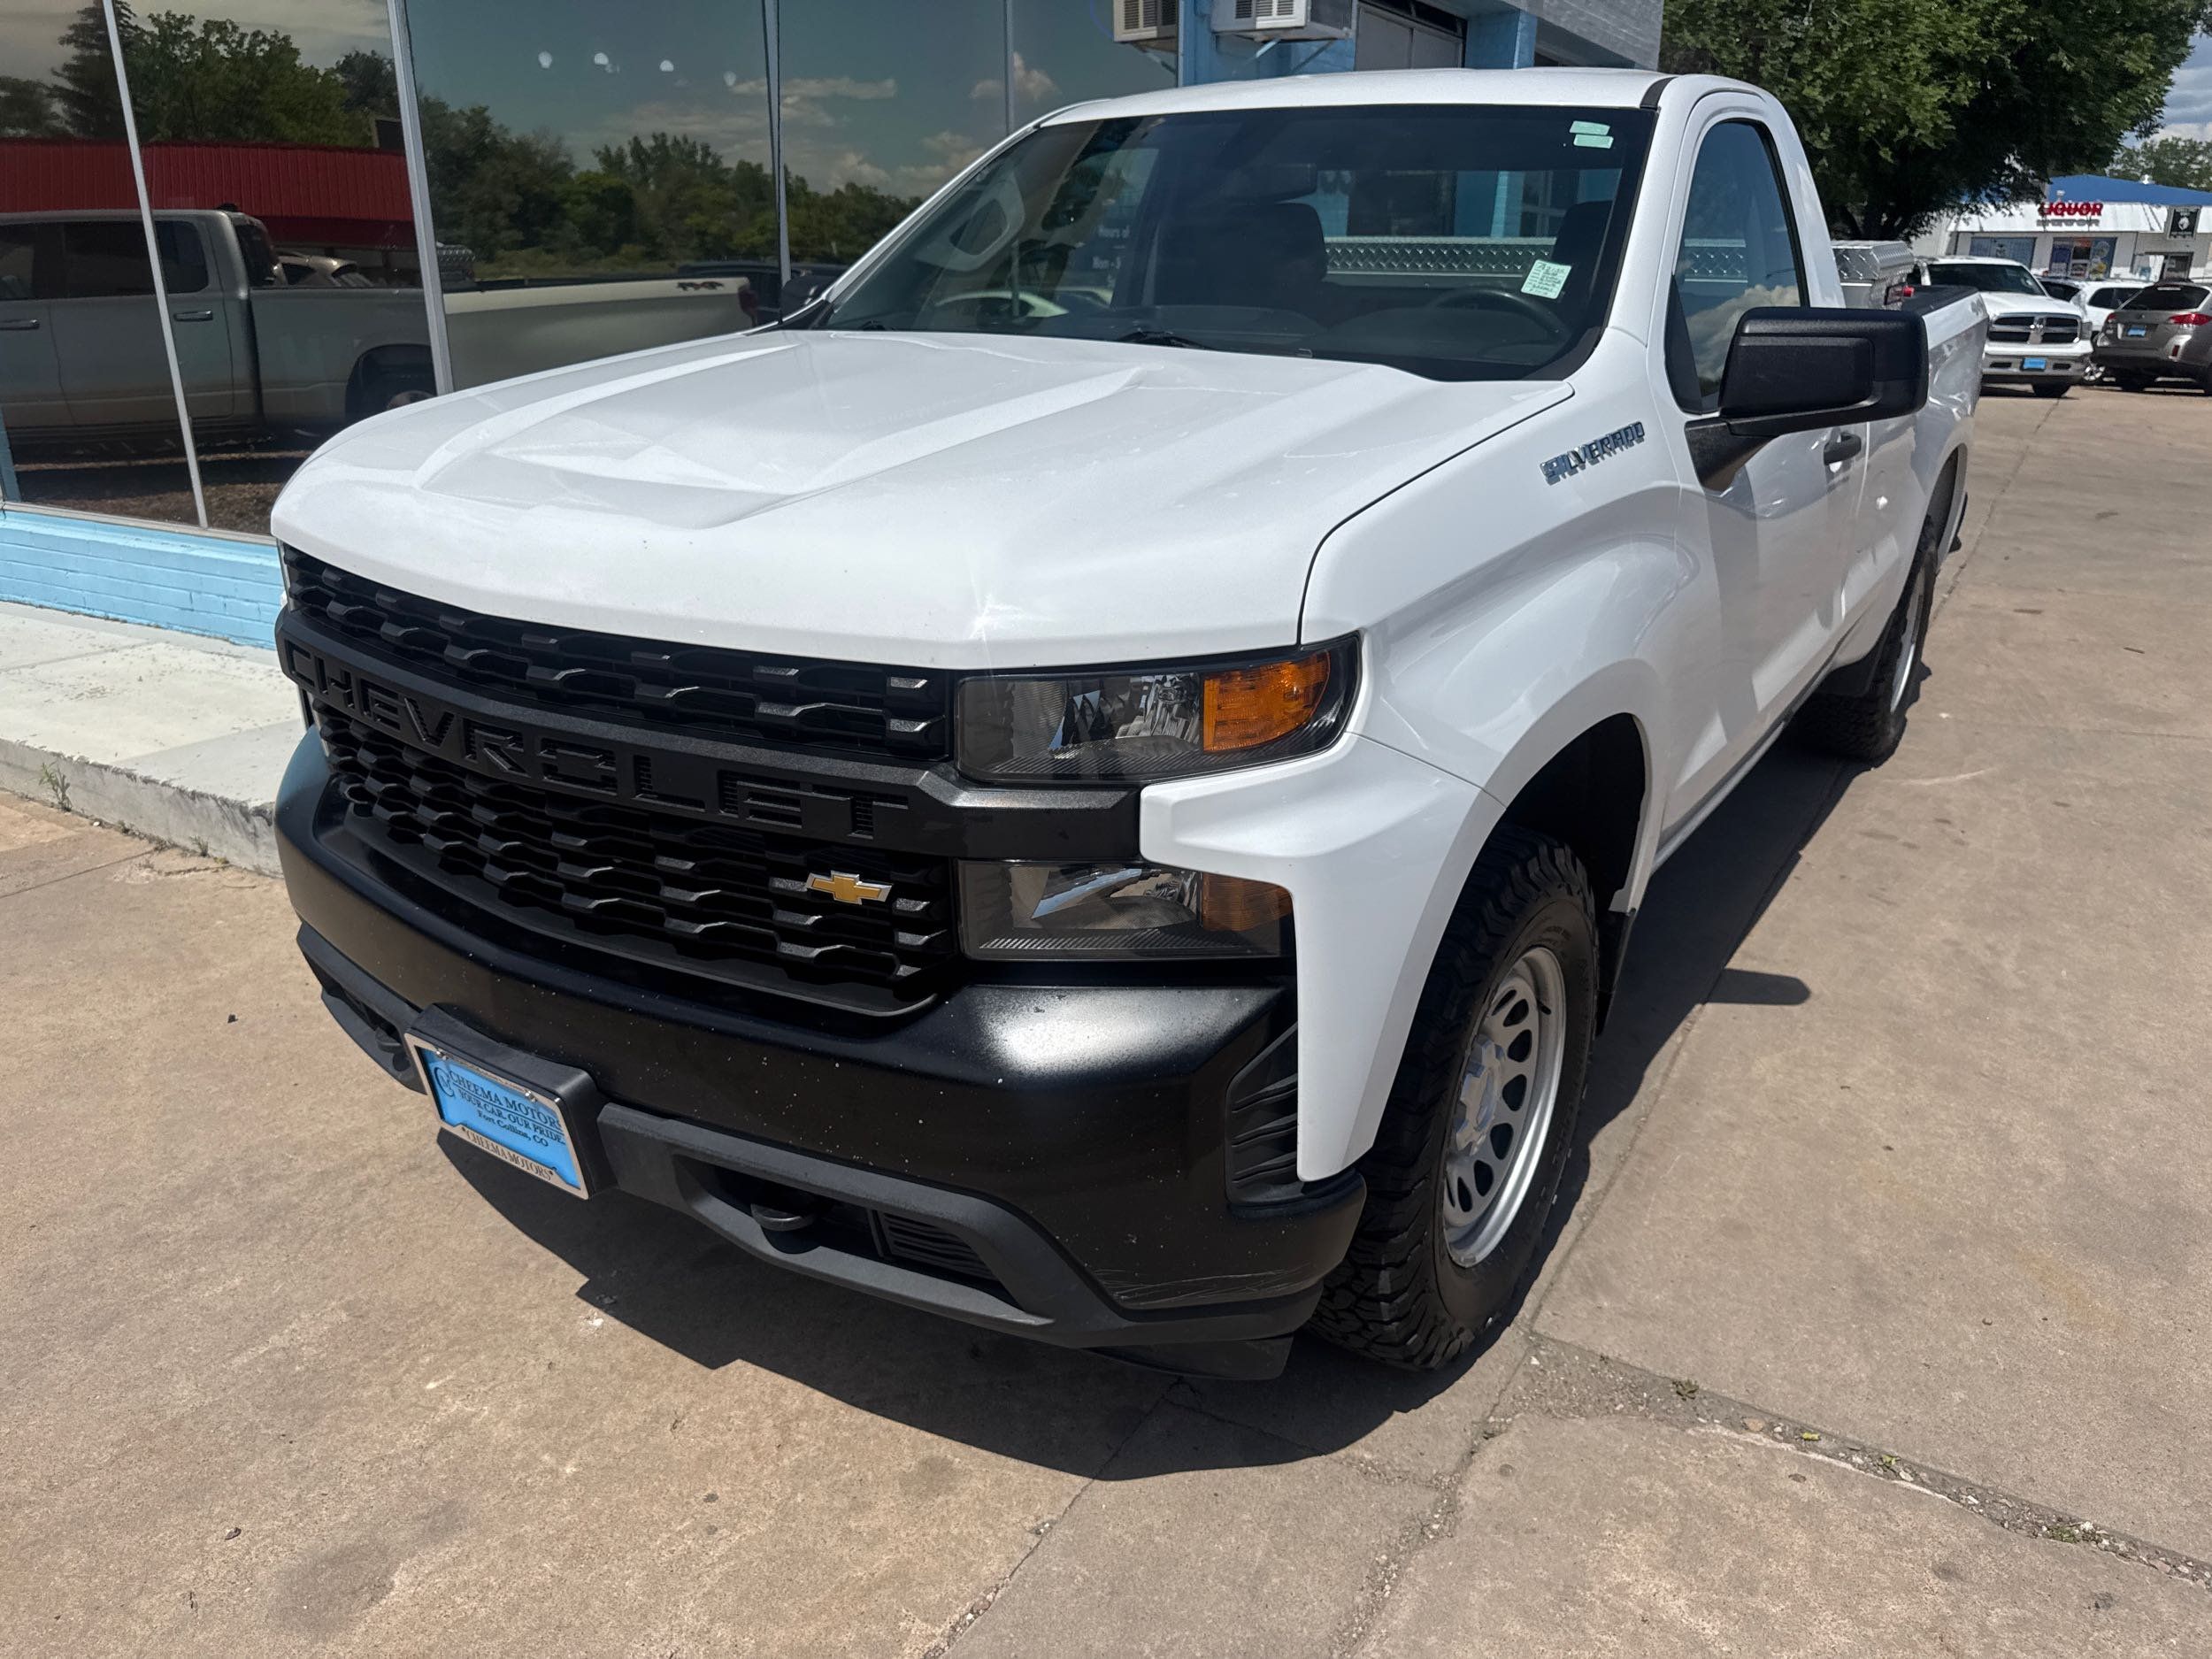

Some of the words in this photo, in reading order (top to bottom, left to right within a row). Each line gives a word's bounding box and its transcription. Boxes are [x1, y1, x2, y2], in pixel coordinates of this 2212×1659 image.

[2038, 203, 2103, 217] LIQUOR
[1540, 421, 1645, 480] SILVERADO
[284, 638, 910, 839] CHEVROLET
[449, 1070, 503, 1106] CHEEMA
[458, 1088, 484, 1110] YOUR
[507, 1113, 531, 1129] OUR
[477, 1110, 496, 1125] Fort
[533, 1134, 549, 1147] CO
[466, 1130, 507, 1160] CHEEMA
[507, 1151, 551, 1181] MOTORS
